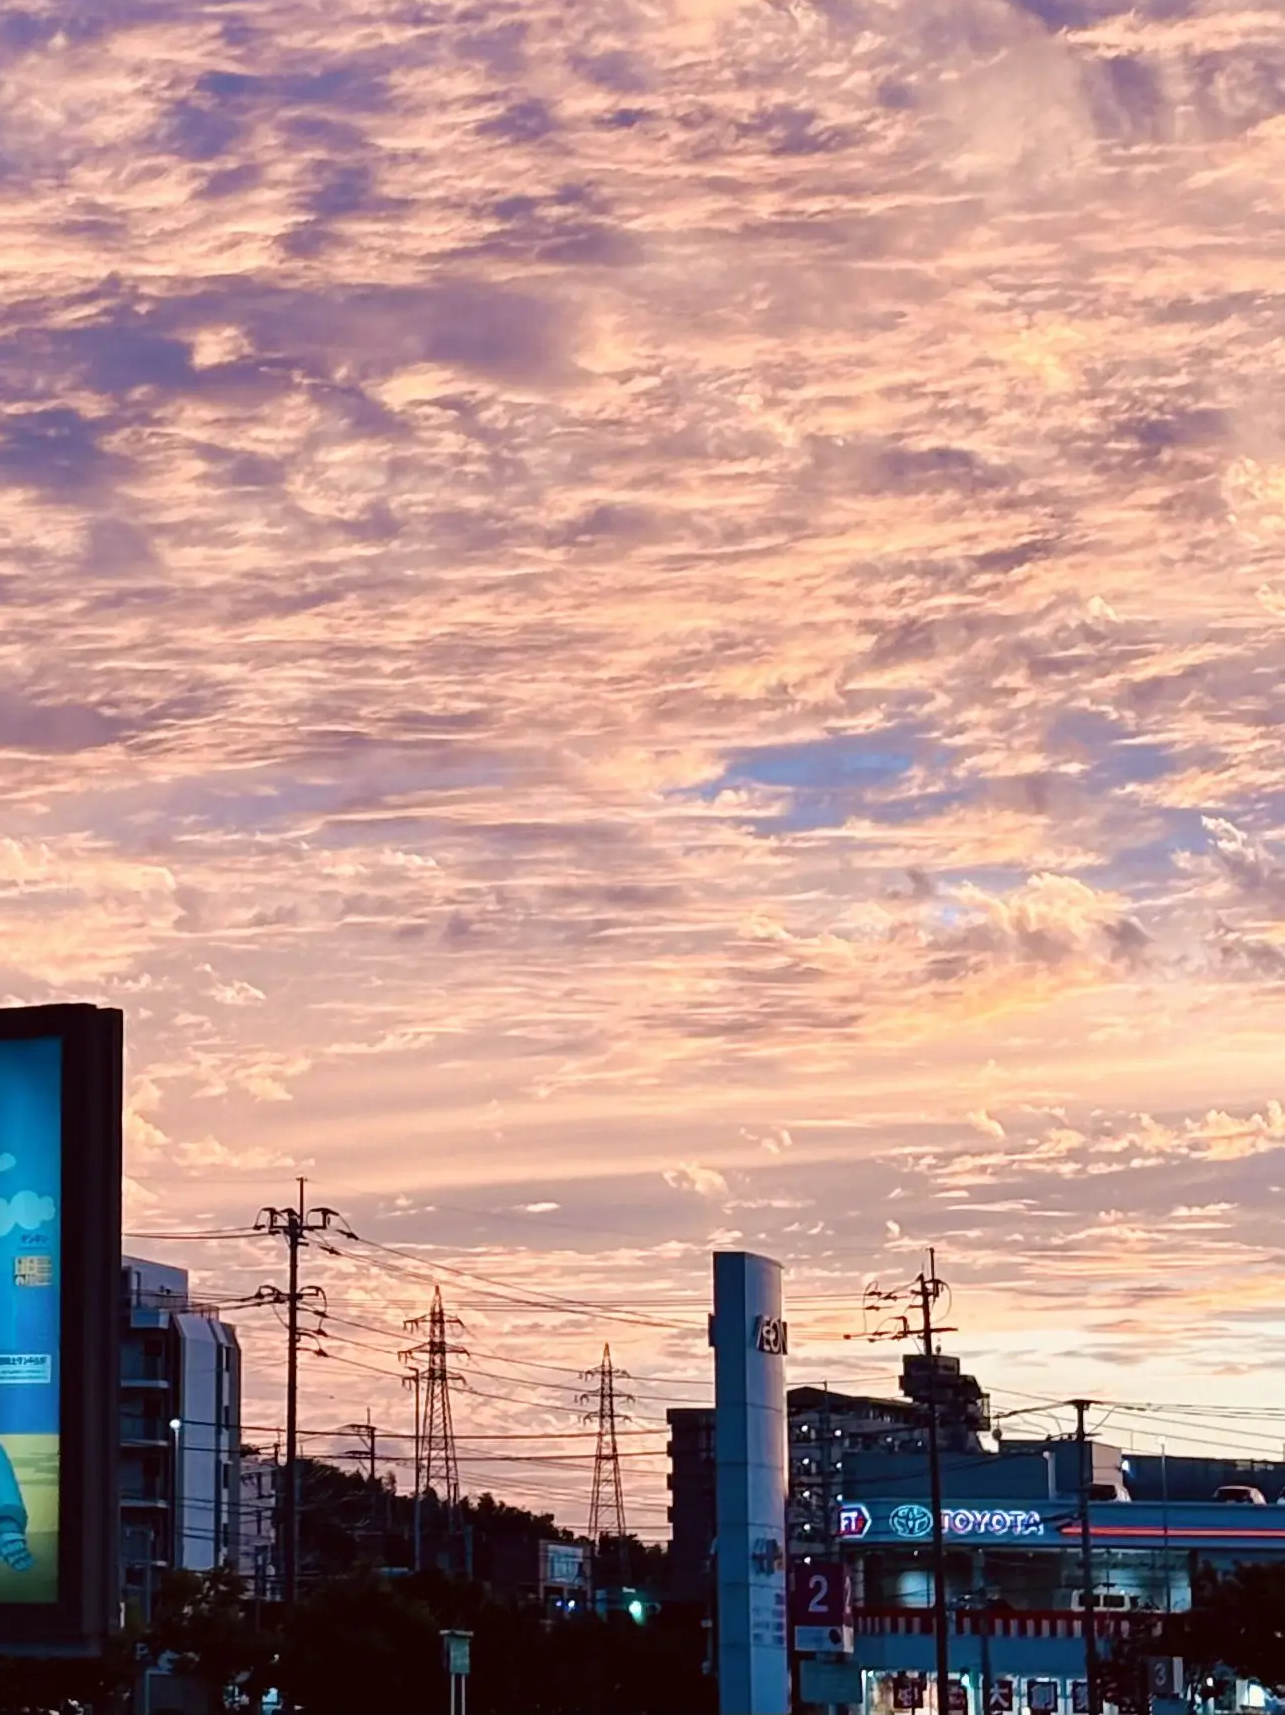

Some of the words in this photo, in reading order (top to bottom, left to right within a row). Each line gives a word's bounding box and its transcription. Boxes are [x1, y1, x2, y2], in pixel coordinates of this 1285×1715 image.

[941, 1509, 1044, 1535] TOYOTA
[808, 1574, 829, 1612] 2
[1154, 1662, 1167, 1686] 3
